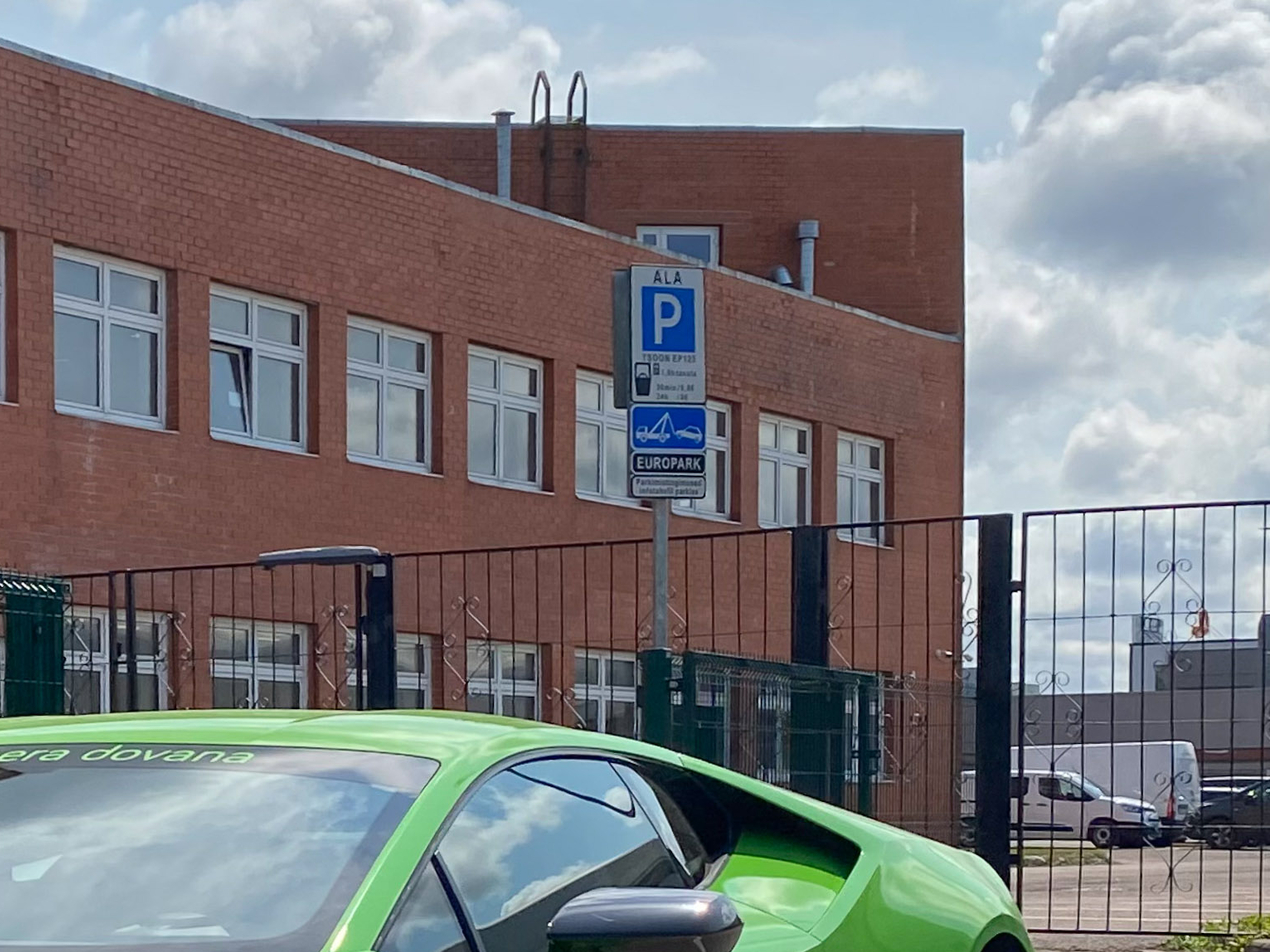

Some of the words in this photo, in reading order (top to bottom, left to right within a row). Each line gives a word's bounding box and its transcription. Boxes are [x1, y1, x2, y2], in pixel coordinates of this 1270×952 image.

[653, 270, 683, 285] ALA
[654, 293, 682, 344] P
[637, 456, 702, 470] EUROPARK
[80, 744, 255, 764] dovana
